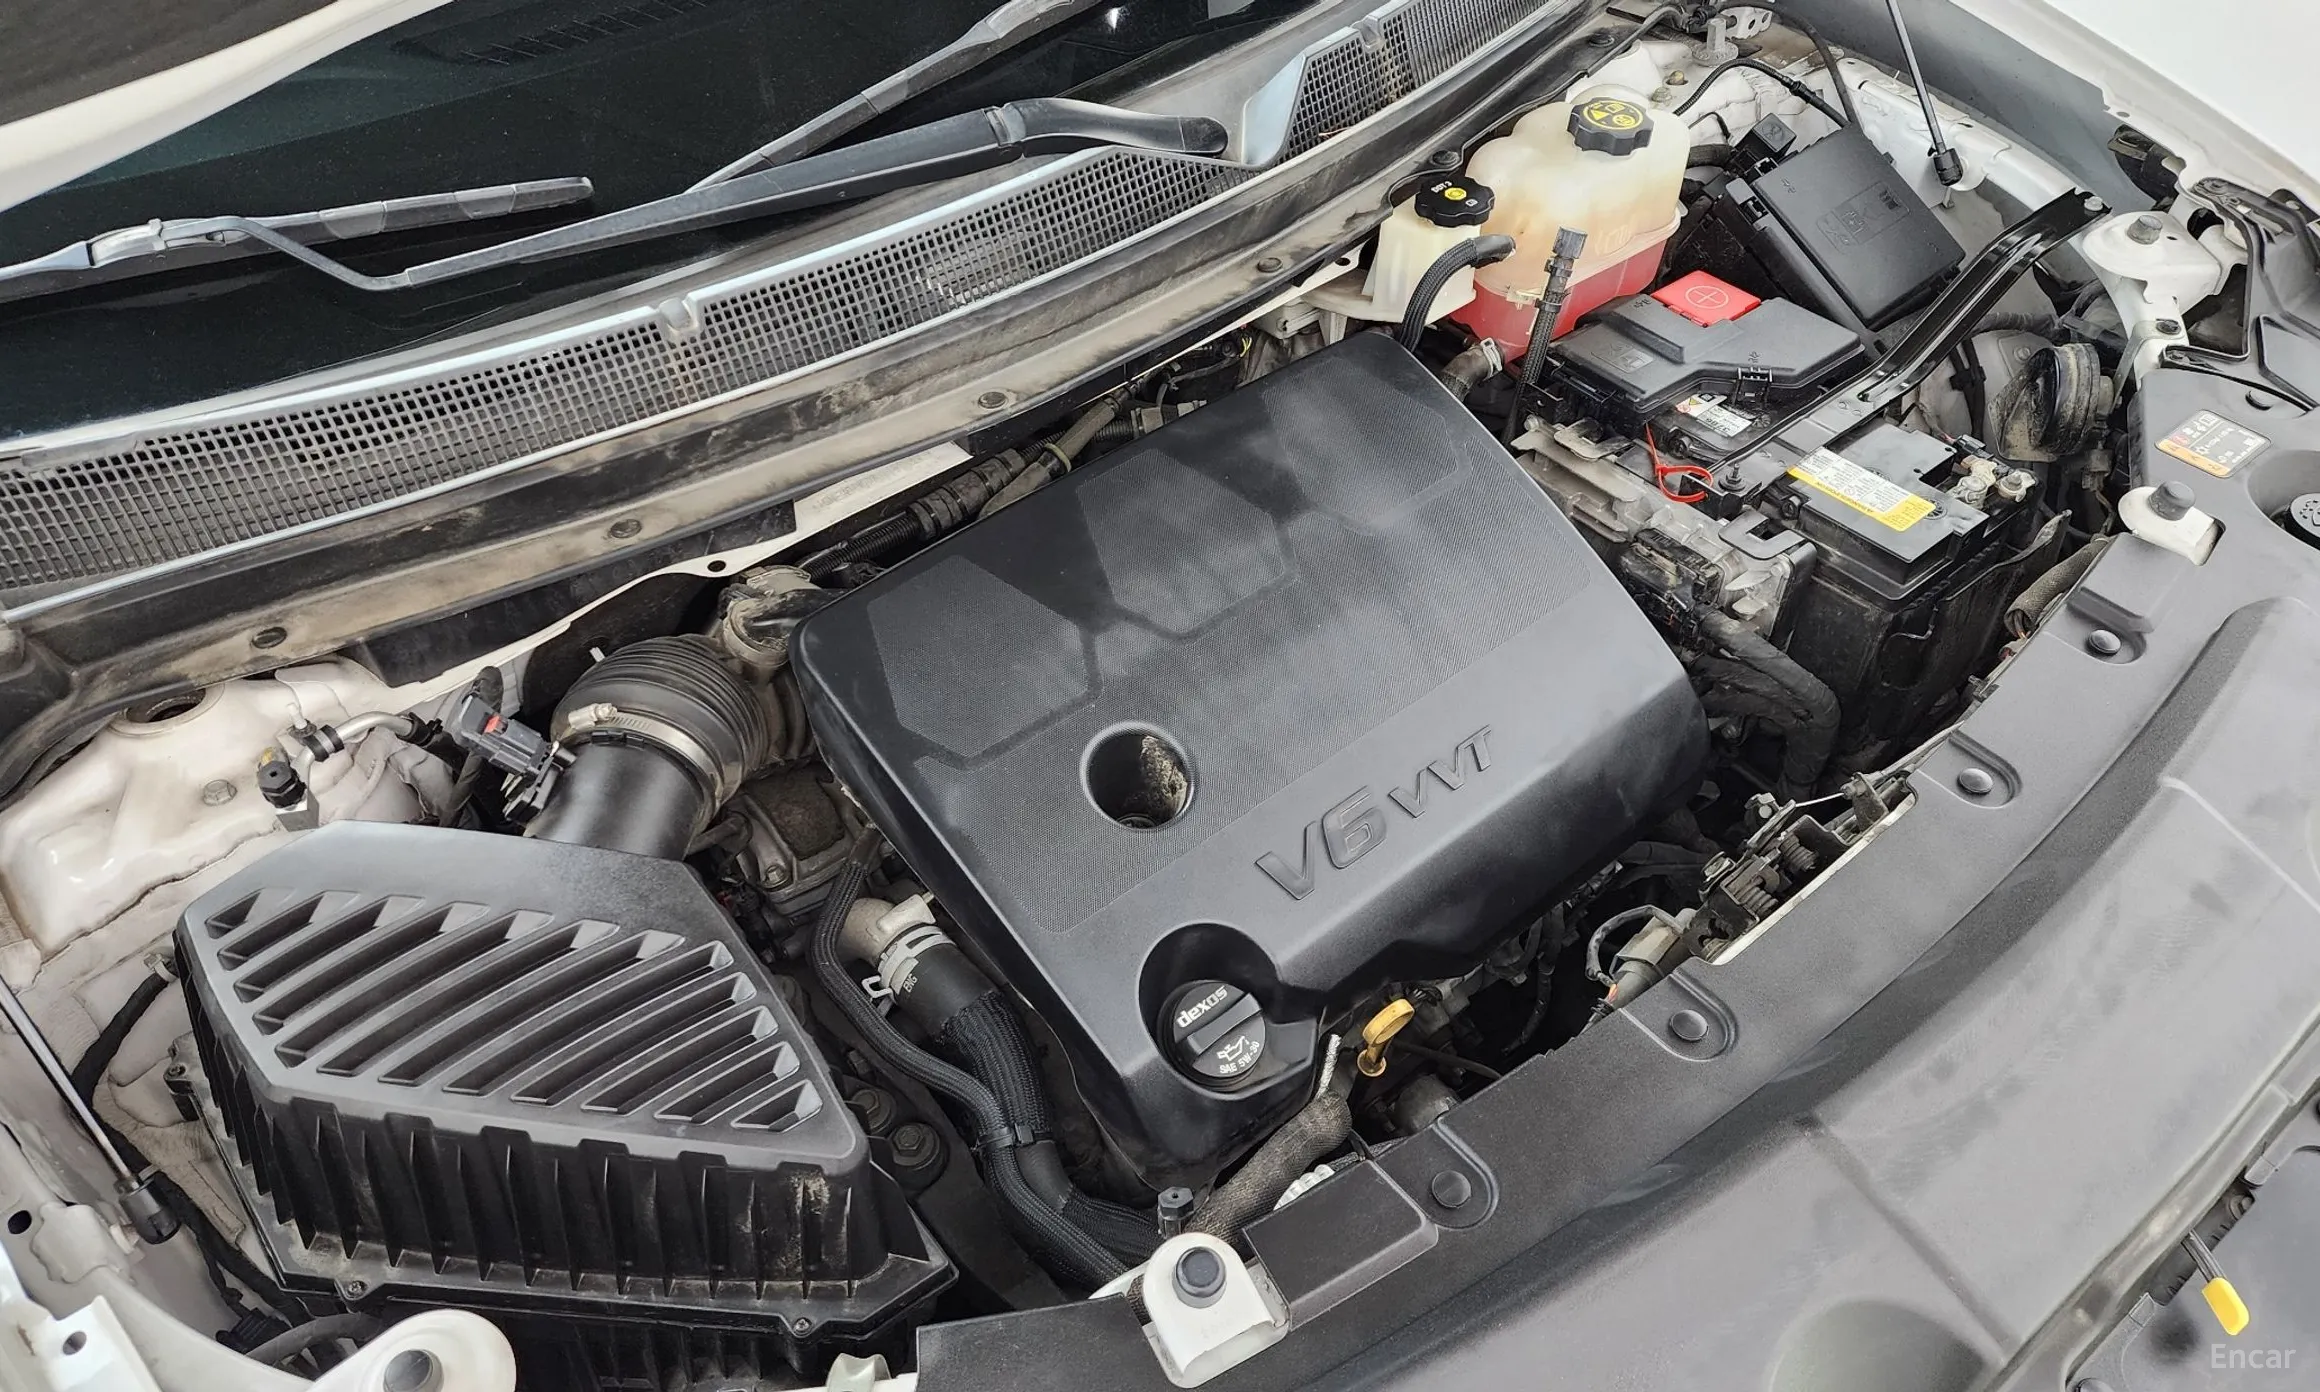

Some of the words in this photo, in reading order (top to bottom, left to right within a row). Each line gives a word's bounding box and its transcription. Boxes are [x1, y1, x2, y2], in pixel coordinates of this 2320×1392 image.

[1431, 183, 1447, 193] DOT
[1255, 785, 1387, 900] V6
[1388, 724, 1491, 818] VVT
[903, 973, 918, 993] ENG
[1176, 985, 1228, 1028] dexos
[1220, 1063, 1237, 1074] SAE
[1238, 1041, 1260, 1067] 5W-30
